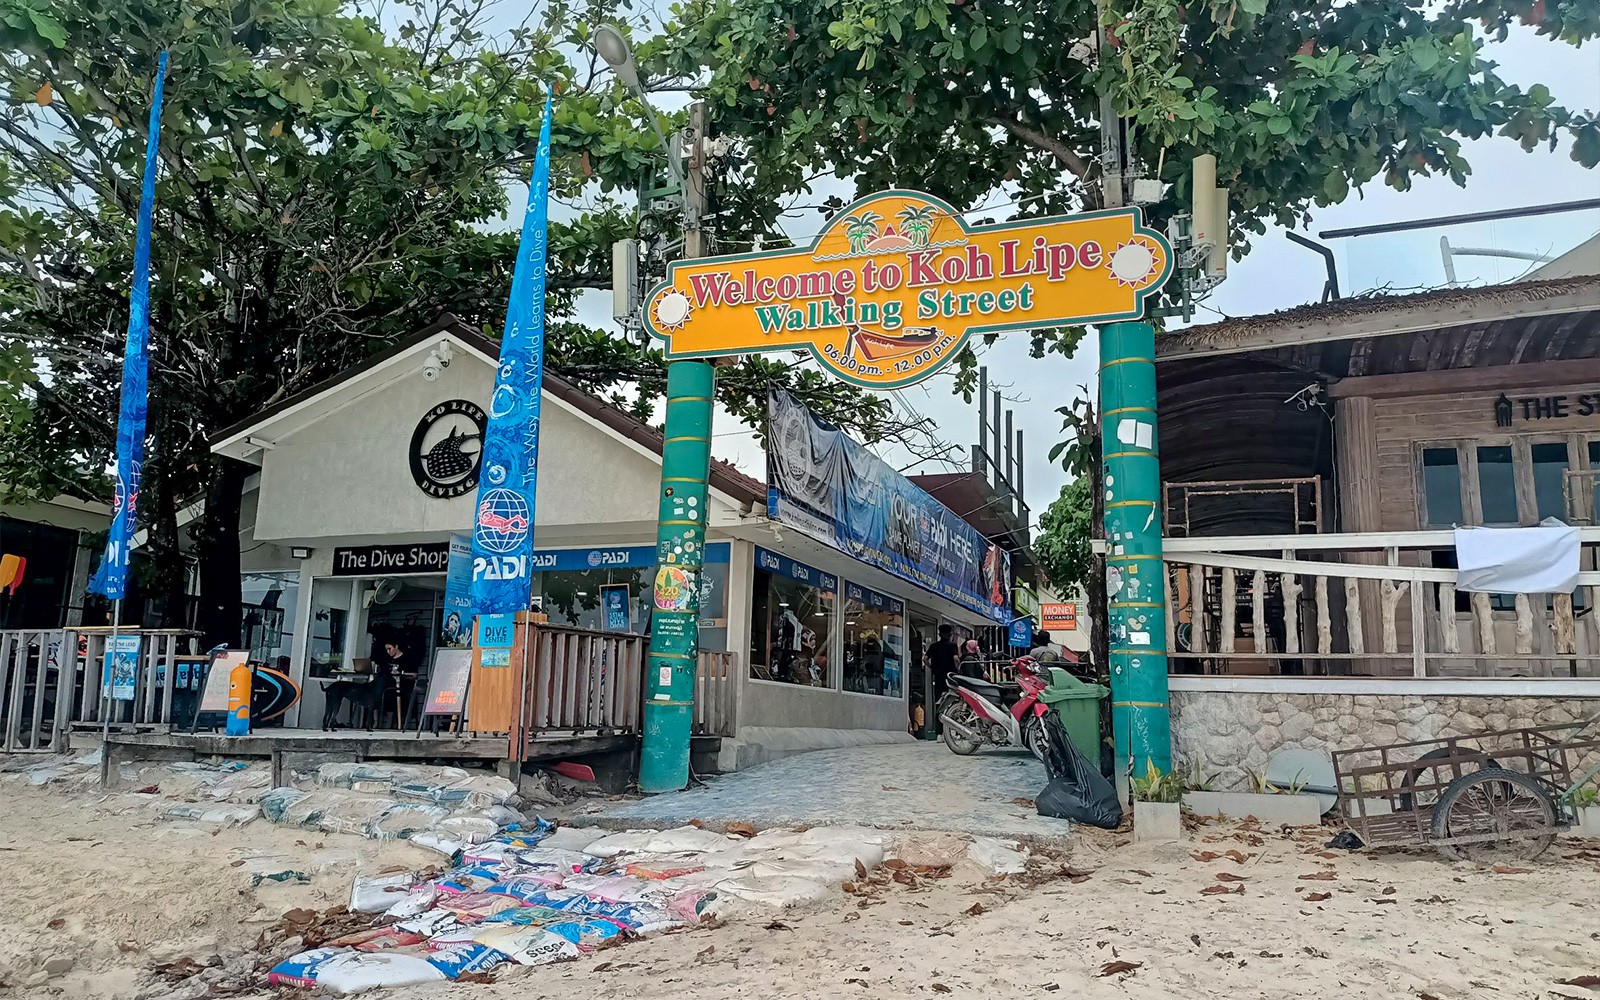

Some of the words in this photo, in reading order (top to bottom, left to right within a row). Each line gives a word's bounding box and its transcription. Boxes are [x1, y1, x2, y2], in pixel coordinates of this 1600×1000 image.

[529, 229, 544, 262] Dive
[530, 266, 542, 281] to
[689, 268, 855, 308] Welcome
[861, 259, 902, 293] to
[906, 243, 994, 288] Koh
[1000, 236, 1103, 282] Lipe
[526, 284, 542, 331] Learns
[755, 297, 903, 333] Walking
[917, 281, 1035, 319] Street
[523, 335, 540, 384] World
[823, 343, 858, 370] 06.00
[857, 364, 883, 375] pm.
[894, 350, 932, 373] 12.00
[932, 334, 957, 356] pm.
[523, 386, 539, 410] the
[1518, 395, 1569, 420] THE
[425, 406, 446, 423] KO
[451, 402, 484, 421] LIPE
[523, 414, 540, 455] Way
[521, 457, 536, 486] The
[421, 477, 475, 496] DIVING
[889, 492, 918, 531] YOUR
[950, 529, 974, 564] HERE
[339, 550, 367, 568] The
[370, 550, 404, 567] Dive
[408, 547, 449, 569] Shop
[473, 555, 526, 582] PADI
[532, 555, 558, 567] PADI
[602, 552, 630, 564] PADI
[767, 555, 780, 570] PADI
[797, 566, 809, 581] PADI
[824, 576, 835, 590] PADI
[455, 597, 472, 607] PADI
[1043, 605, 1074, 615] MONEY
[485, 626, 507, 637] DIVE
